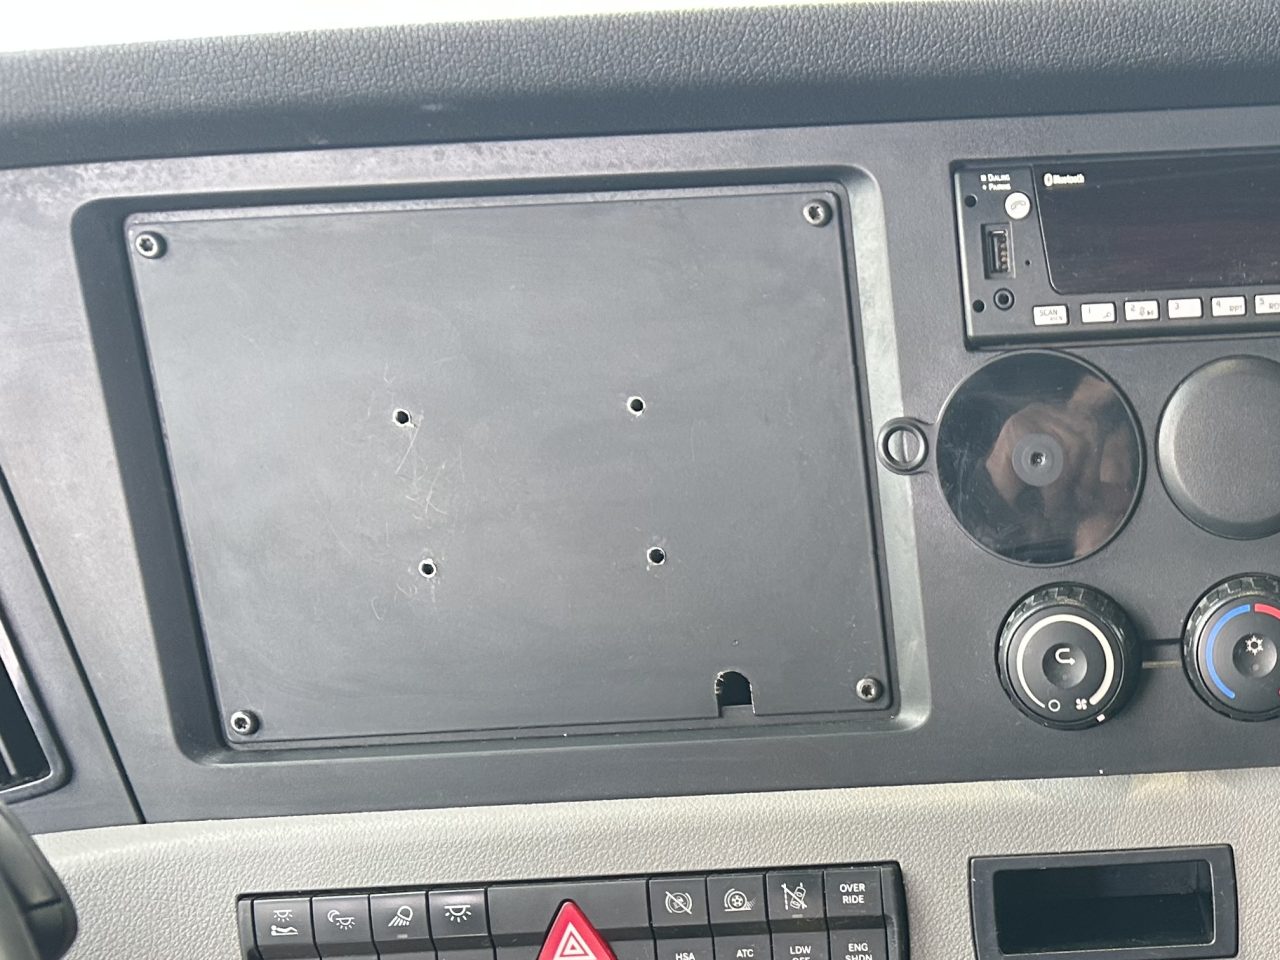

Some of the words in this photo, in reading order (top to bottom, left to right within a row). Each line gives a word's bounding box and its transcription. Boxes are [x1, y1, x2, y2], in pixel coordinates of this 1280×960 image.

[839, 883, 866, 894] OVER
[842, 894, 865, 905] RIDE
[736, 948, 754, 958] ATC
[789, 945, 812, 955] LDW
[848, 943, 869, 953] ENG
